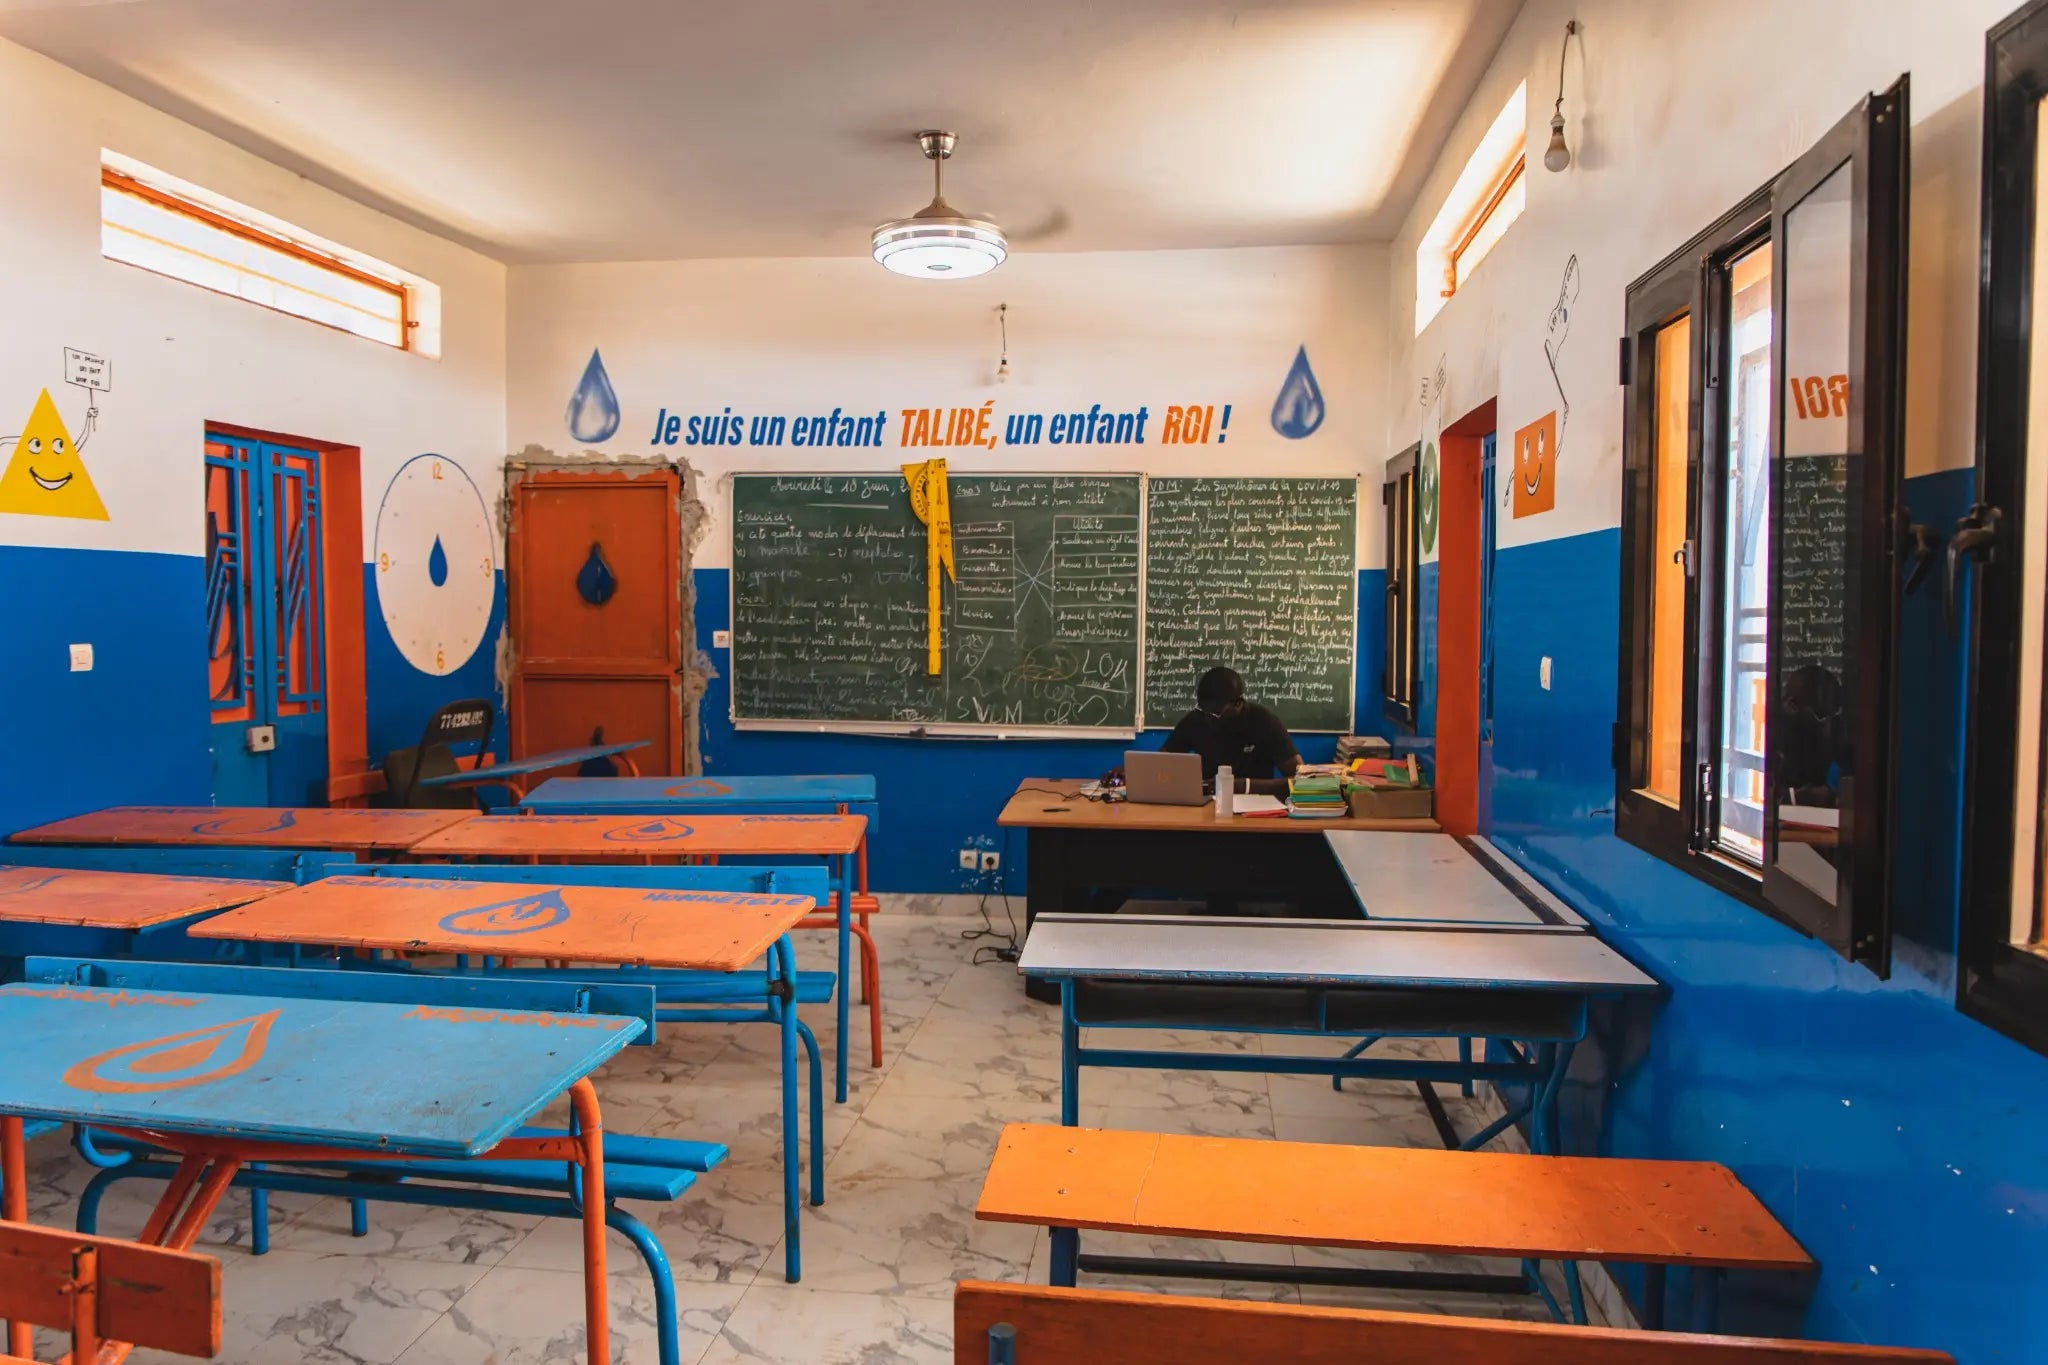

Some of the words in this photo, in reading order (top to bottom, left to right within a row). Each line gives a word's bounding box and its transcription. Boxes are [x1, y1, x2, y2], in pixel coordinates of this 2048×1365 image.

[651, 408, 681, 446] Je
[685, 407, 744, 446] suis
[749, 416, 786, 446] un
[790, 407, 887, 447] enfant
[899, 400, 998, 450] TALIBÉ,
[1004, 414, 1043, 445] un
[1048, 403, 1149, 444] enfant
[1161, 405, 1214, 444] ROI
[1217, 404, 1232, 443] !
[432, 462, 444, 480] 12
[380, 553, 389, 572] 9
[484, 557, 492, 578] 3
[436, 651, 445, 669] 6
